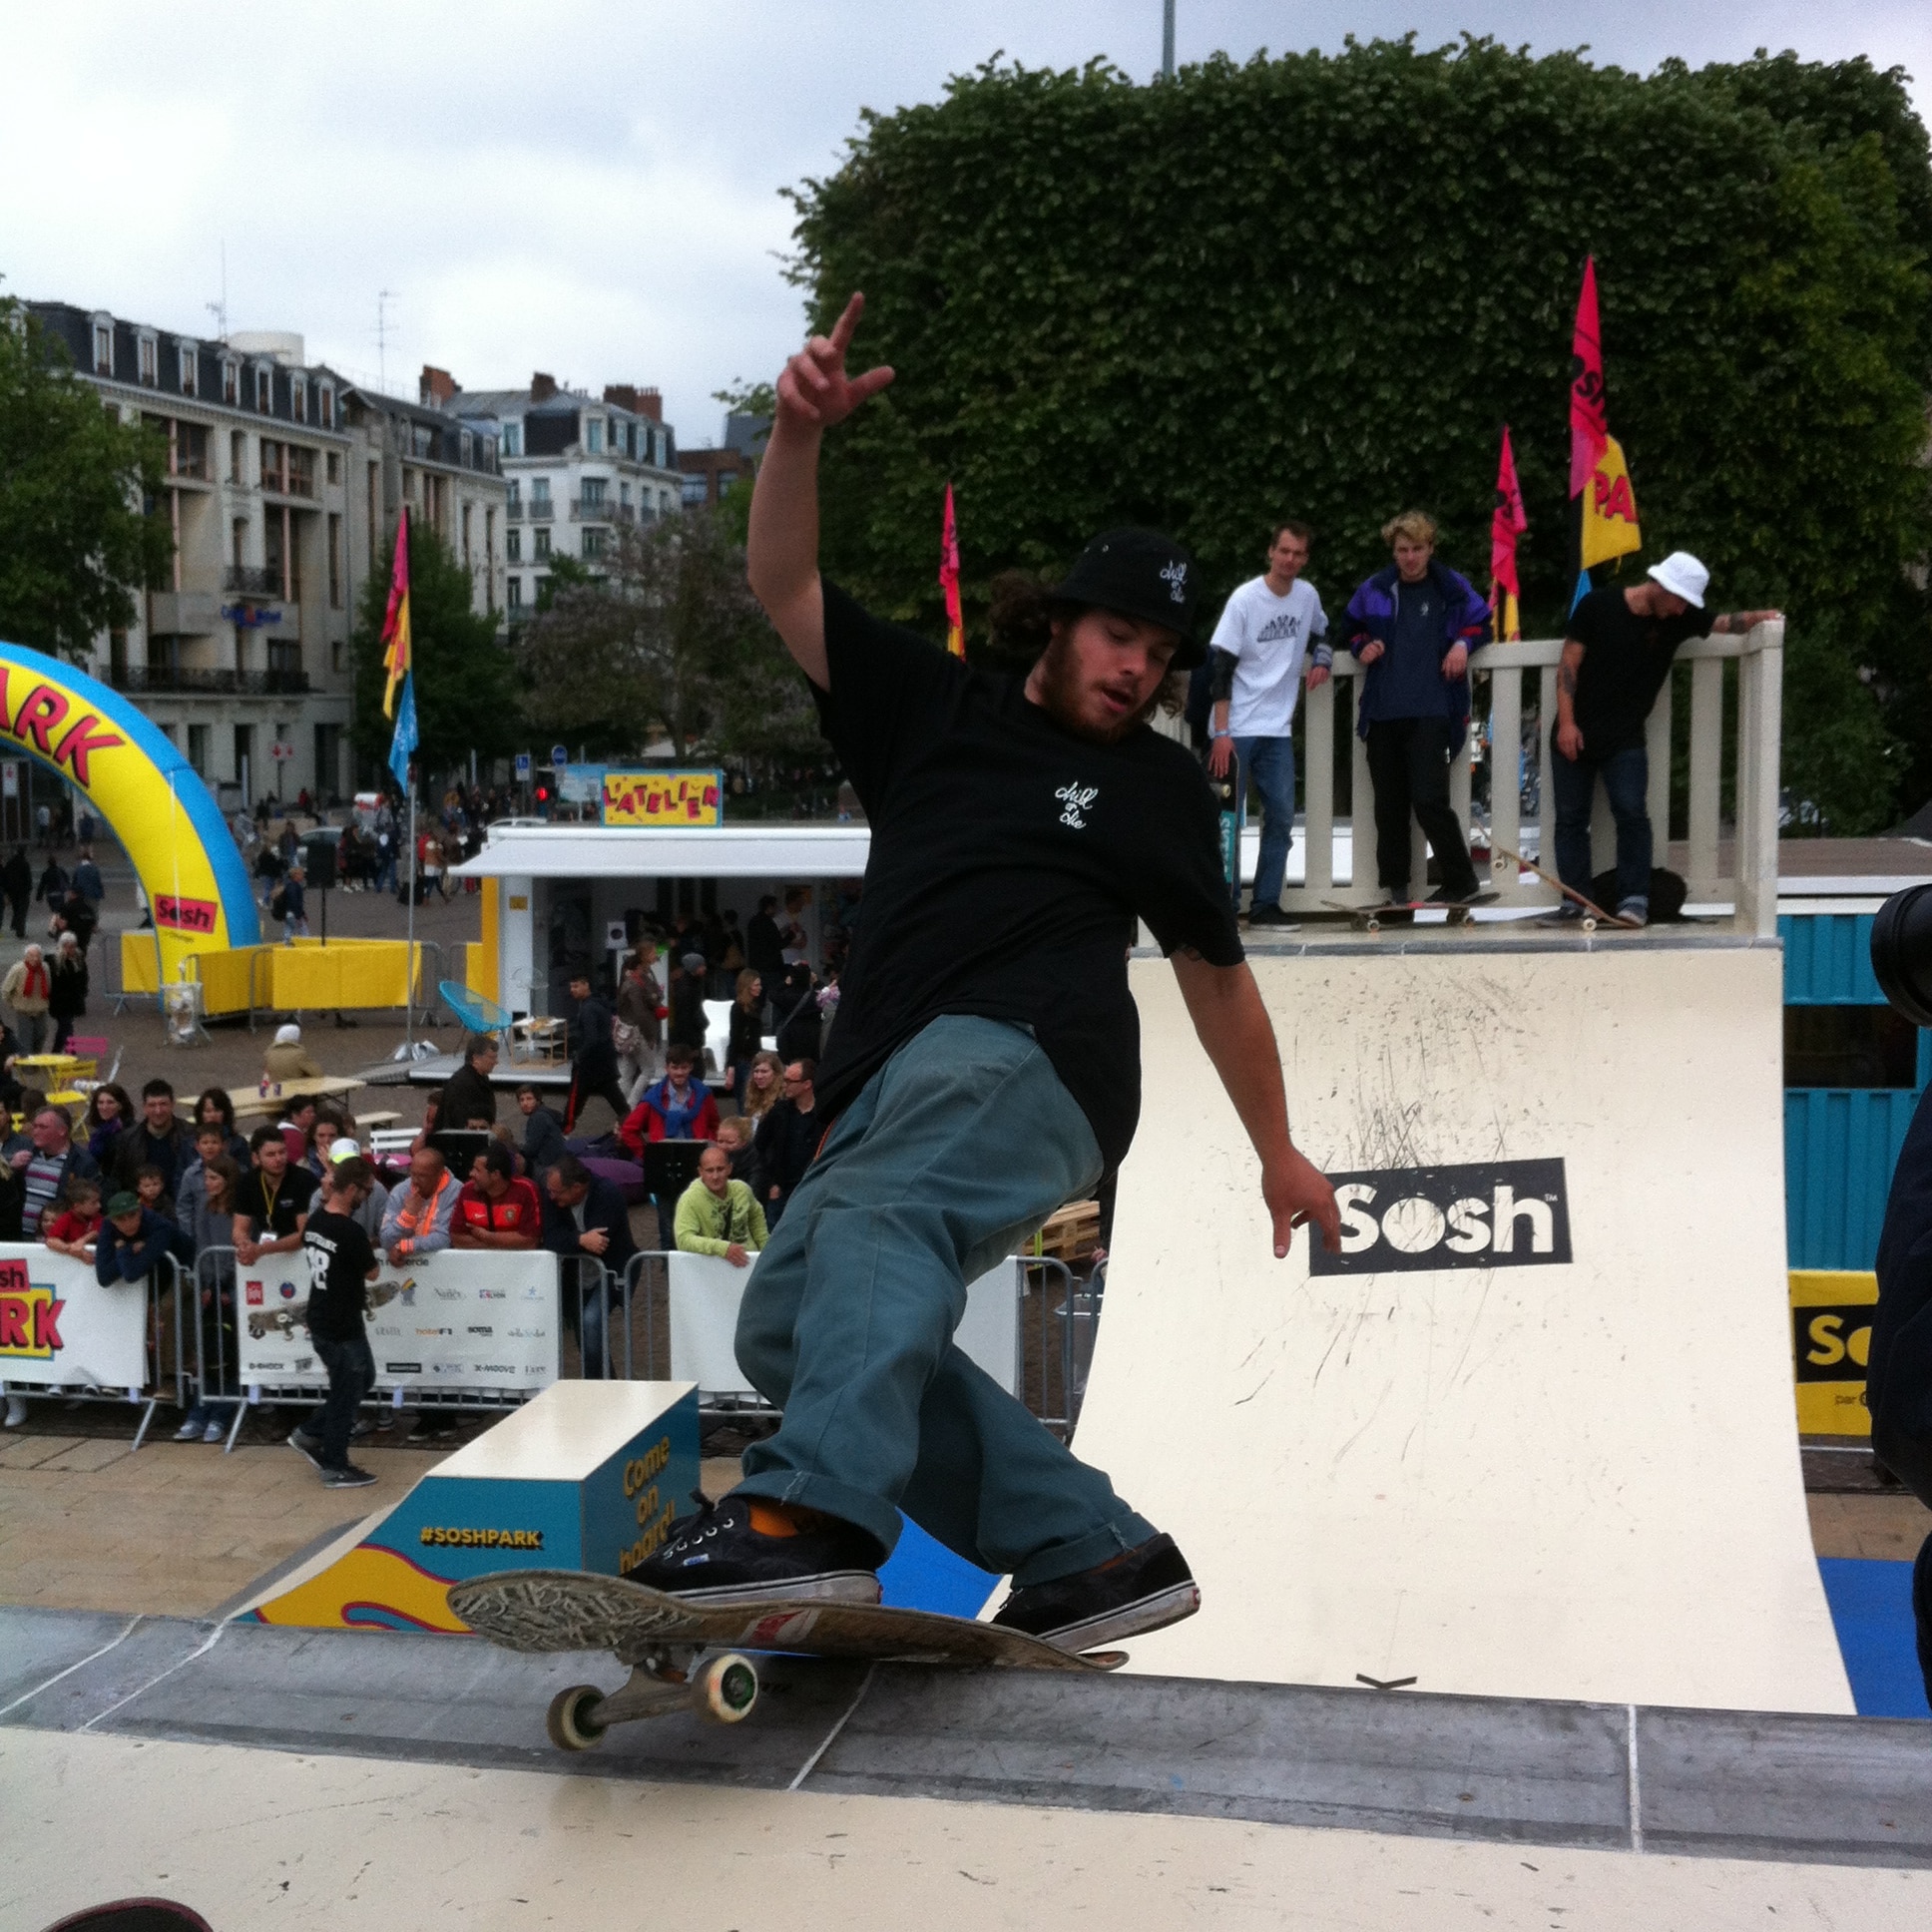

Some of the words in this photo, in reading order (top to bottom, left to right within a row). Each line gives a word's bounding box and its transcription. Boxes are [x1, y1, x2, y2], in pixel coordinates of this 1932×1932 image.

[0, 668, 126, 788] RK
[602, 780, 721, 819] L'ATELIER
[159, 899, 210, 928] Sosh
[1334, 1183, 1554, 1253] Sosh
[623, 1436, 670, 1500] Come
[636, 1485, 659, 1527] on
[420, 1527, 544, 1551] #SOSHPARK
